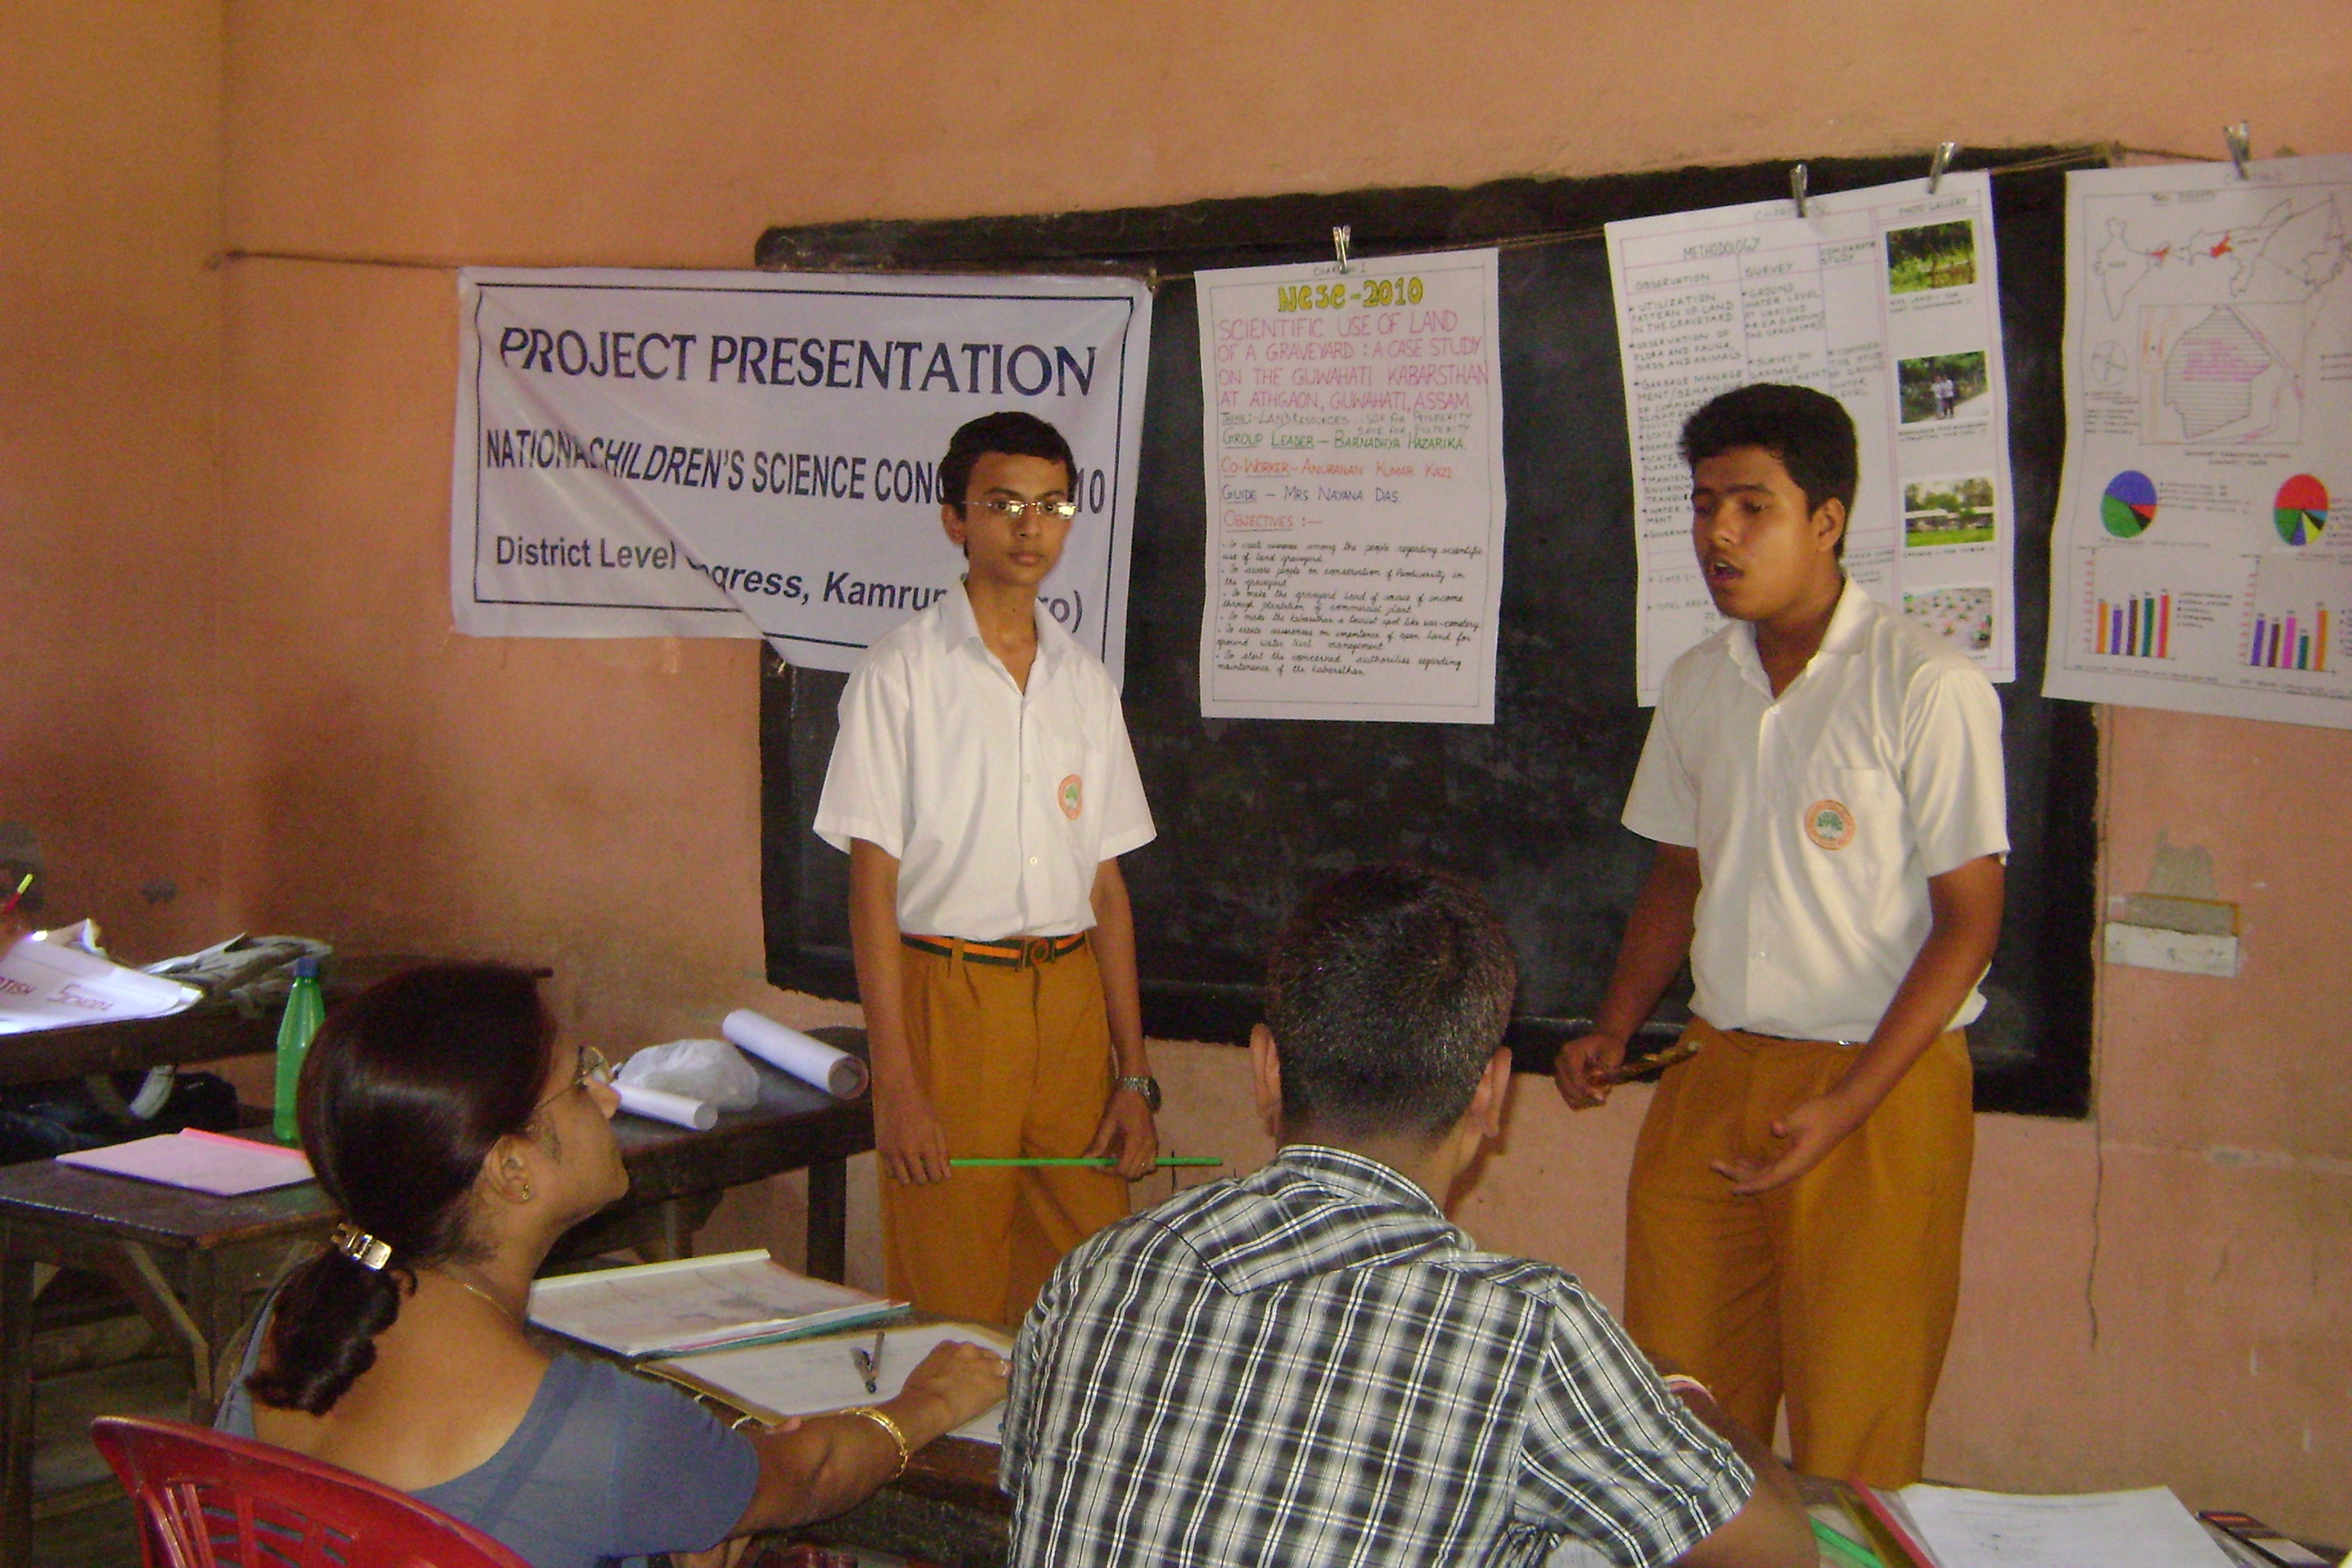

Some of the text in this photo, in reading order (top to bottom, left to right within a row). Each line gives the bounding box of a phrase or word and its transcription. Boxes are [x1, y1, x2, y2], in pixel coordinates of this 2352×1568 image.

[1218, 310, 1458, 341] SCIENTIFIC USE OF LAND
[1217, 336, 1482, 362] OF A GRAVEYARD A CASE STUDY
[499, 327, 1097, 397] PROJECT PRESENTATION
[1218, 364, 1489, 387] ON THE GUWAHATI KABARSTHAN
[1220, 390, 1239, 407] AT
[1223, 427, 1263, 446] GROUP
[1271, 429, 1315, 448] LEADER
[751, 451, 867, 500] SCIENCE
[1375, 460, 1414, 477] KUMAR
[1221, 484, 1399, 503] GUIDE MRS NAYANA DAS
[1224, 509, 1294, 528] OBJECTIVES
[496, 534, 592, 568] District
[599, 537, 677, 570] Level
